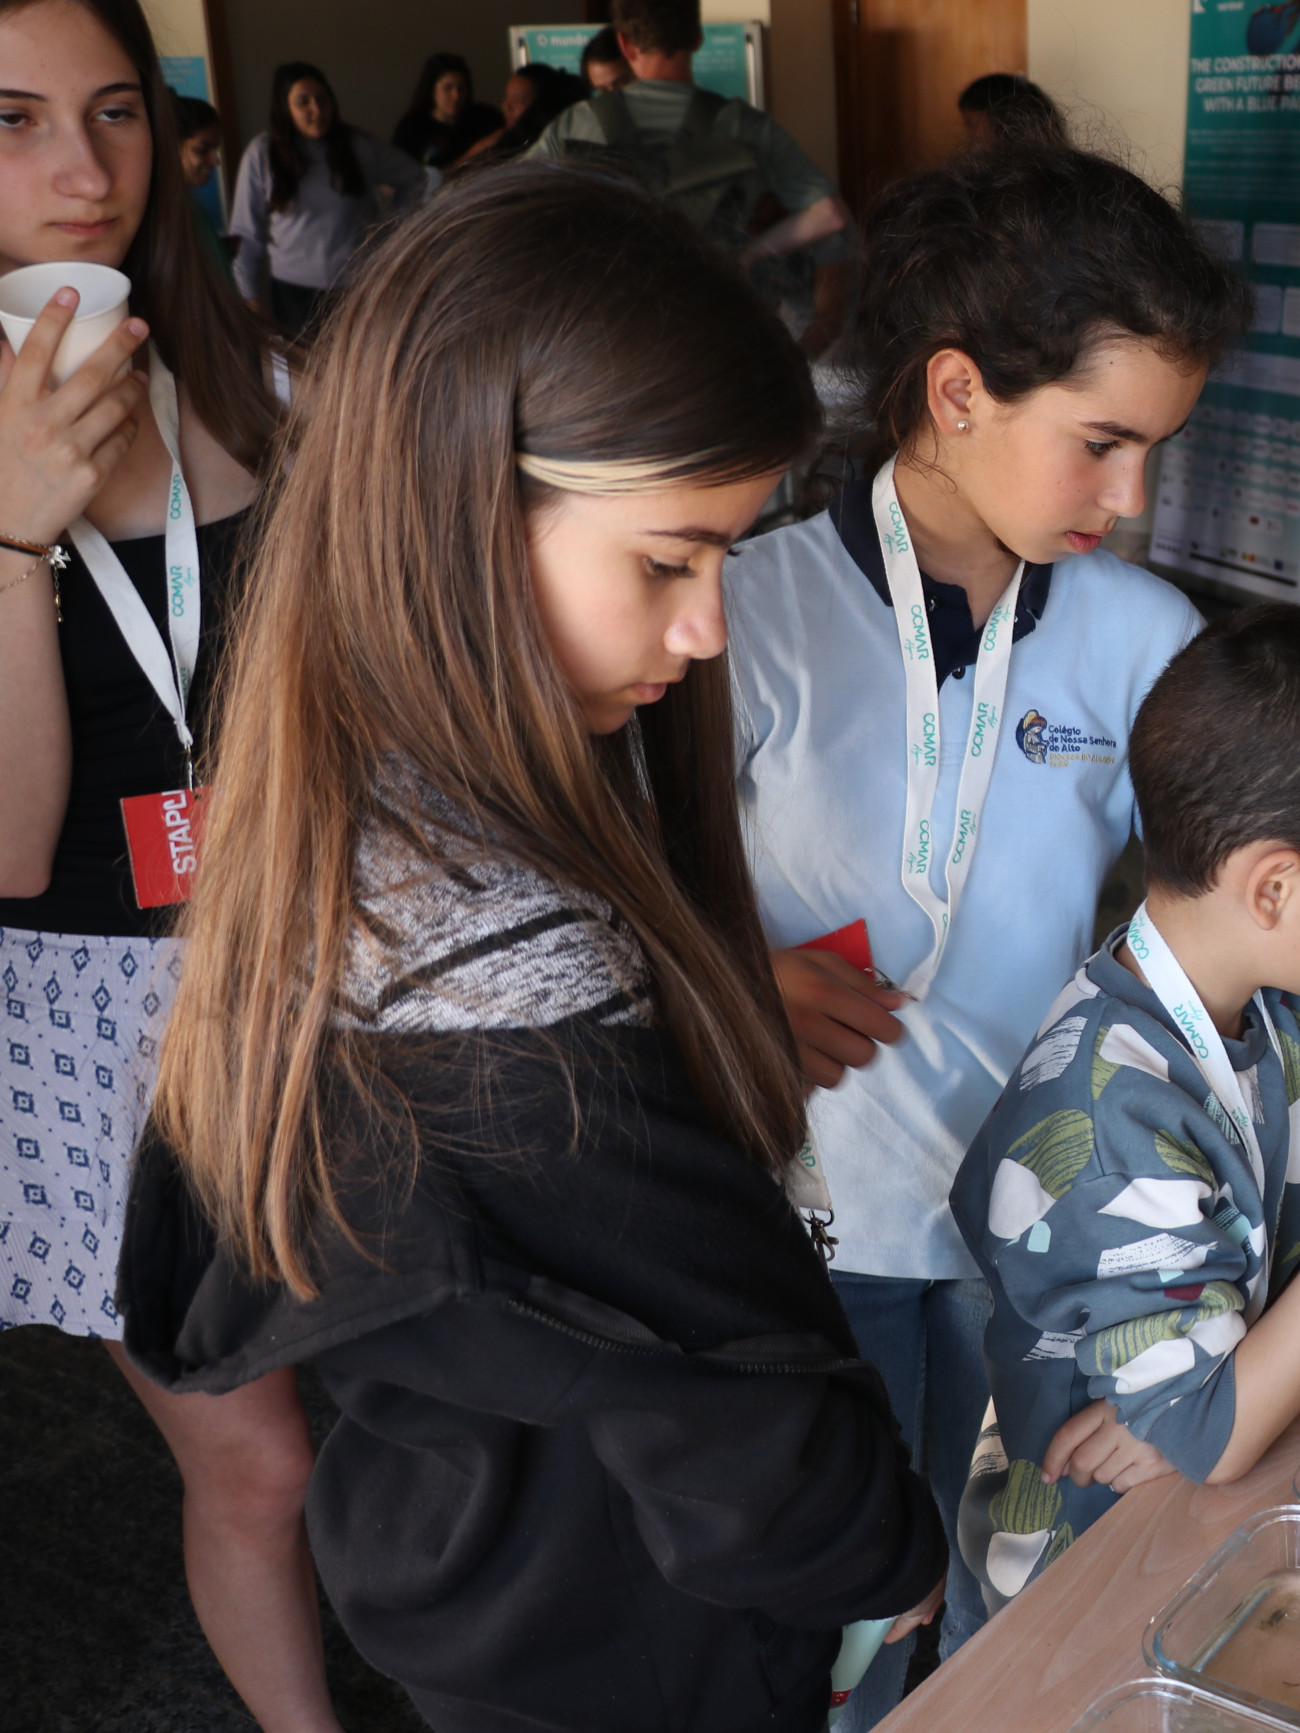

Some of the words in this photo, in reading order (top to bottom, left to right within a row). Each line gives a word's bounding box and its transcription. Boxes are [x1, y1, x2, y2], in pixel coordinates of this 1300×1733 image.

[1191, 58, 1211, 74] THE
[1196, 76, 1233, 93] GREEN
[1236, 75, 1281, 92] FUTURE
[1204, 97, 1235, 113] WITH
[1235, 96, 1245, 112] A
[1247, 95, 1278, 112] BLUE
[888, 501, 910, 554] CCMAR
[170, 566, 184, 617] CCMAR
[911, 604, 930, 660] CCMAR
[923, 713, 937, 767] CCMAR
[971, 702, 990, 758] CCMAR
[1048, 725, 1082, 737] Colégio
[1048, 734, 1059, 744] de
[1060, 735, 1088, 745] Nossa
[1089, 736, 1117, 749] Senhora
[1061, 744, 1082, 753] Alto
[915, 819, 930, 874] CCMAR
[952, 809, 972, 865] CCMAR
[1173, 1003, 1209, 1059] CCMAR
